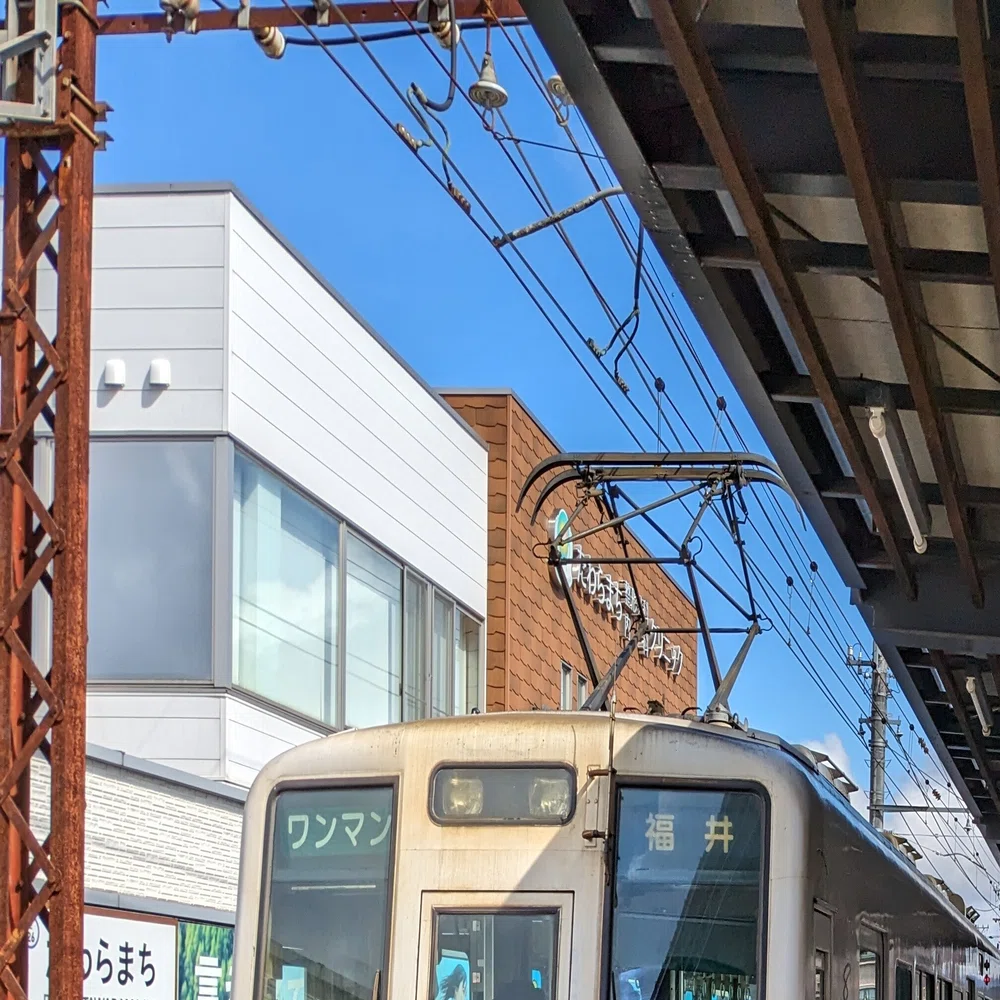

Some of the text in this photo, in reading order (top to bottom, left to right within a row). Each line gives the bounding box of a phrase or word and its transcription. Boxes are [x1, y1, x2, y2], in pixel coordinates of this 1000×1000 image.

[288, 811, 392, 849] ワンマン
[645, 812, 734, 853] 福井
